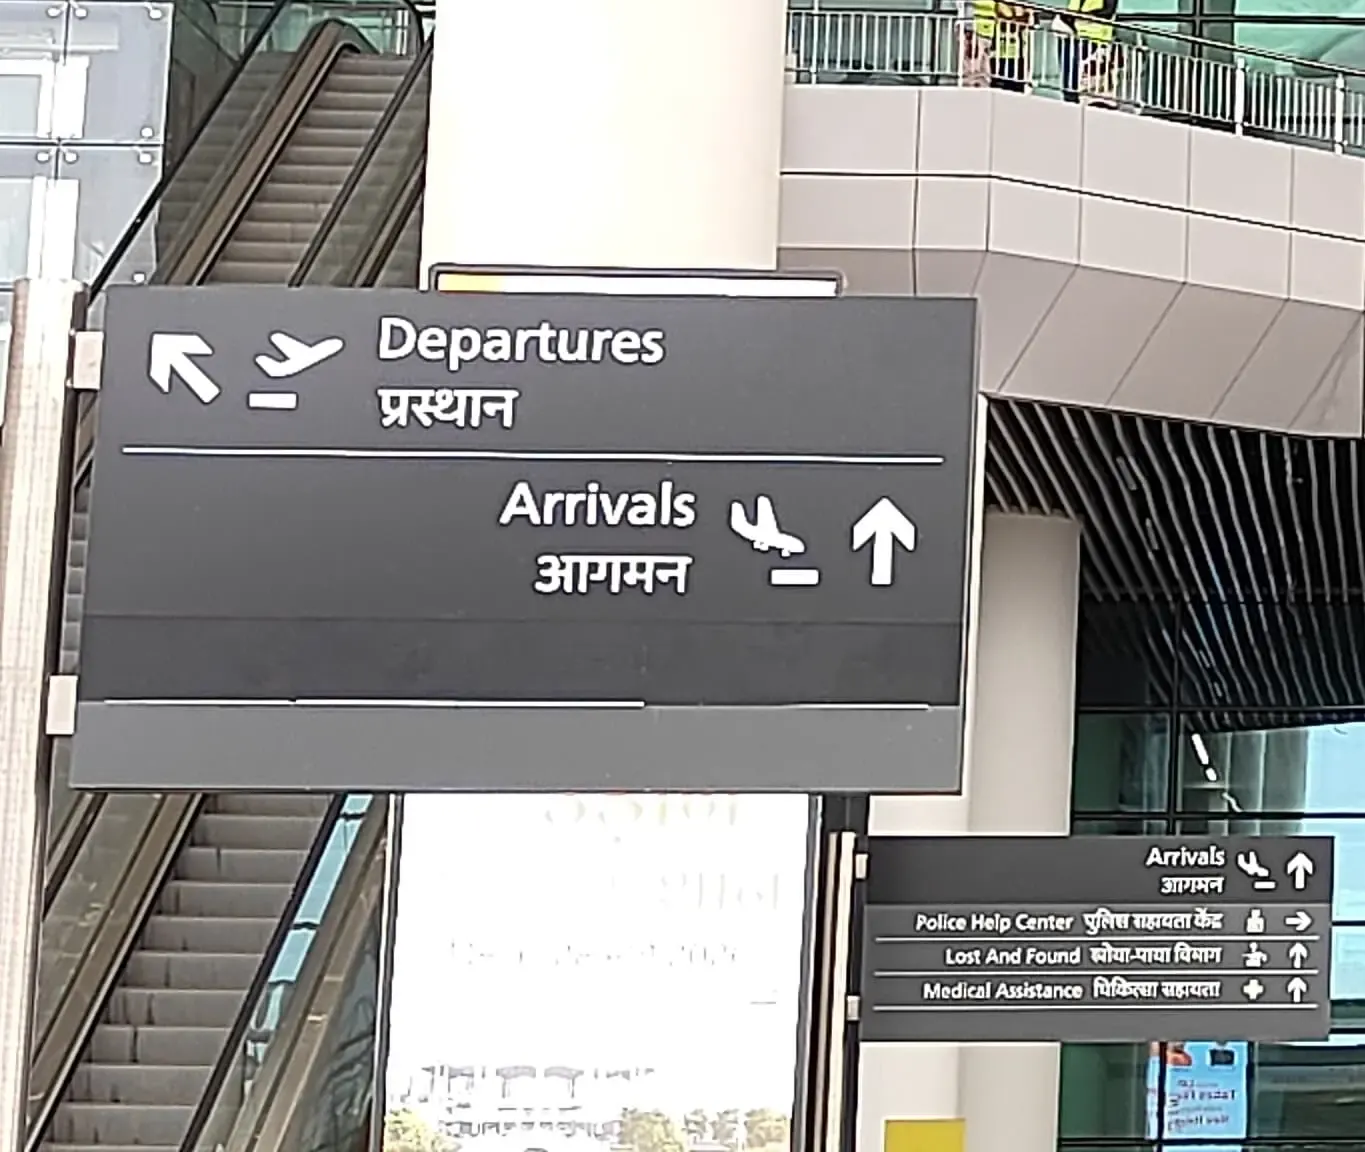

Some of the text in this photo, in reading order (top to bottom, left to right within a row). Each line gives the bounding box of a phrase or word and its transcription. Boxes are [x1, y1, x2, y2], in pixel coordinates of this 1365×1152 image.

[378, 316, 665, 372] Departures
[375, 388, 521, 428] प्रस्थान
[499, 480, 697, 528] Arrivals
[532, 553, 693, 594] आगमन
[1145, 845, 1227, 868] Arrivals
[1160, 876, 1225, 894] आगमन
[915, 911, 1075, 936] Police Help Center
[1082, 907, 1130, 936] पुलिस
[945, 947, 1081, 965] Lost And Found
[1089, 941, 1223, 964] खोया-पाया विभाग
[923, 982, 1083, 1000] Medical Assistance
[1161, 981, 1221, 999] सहायता
